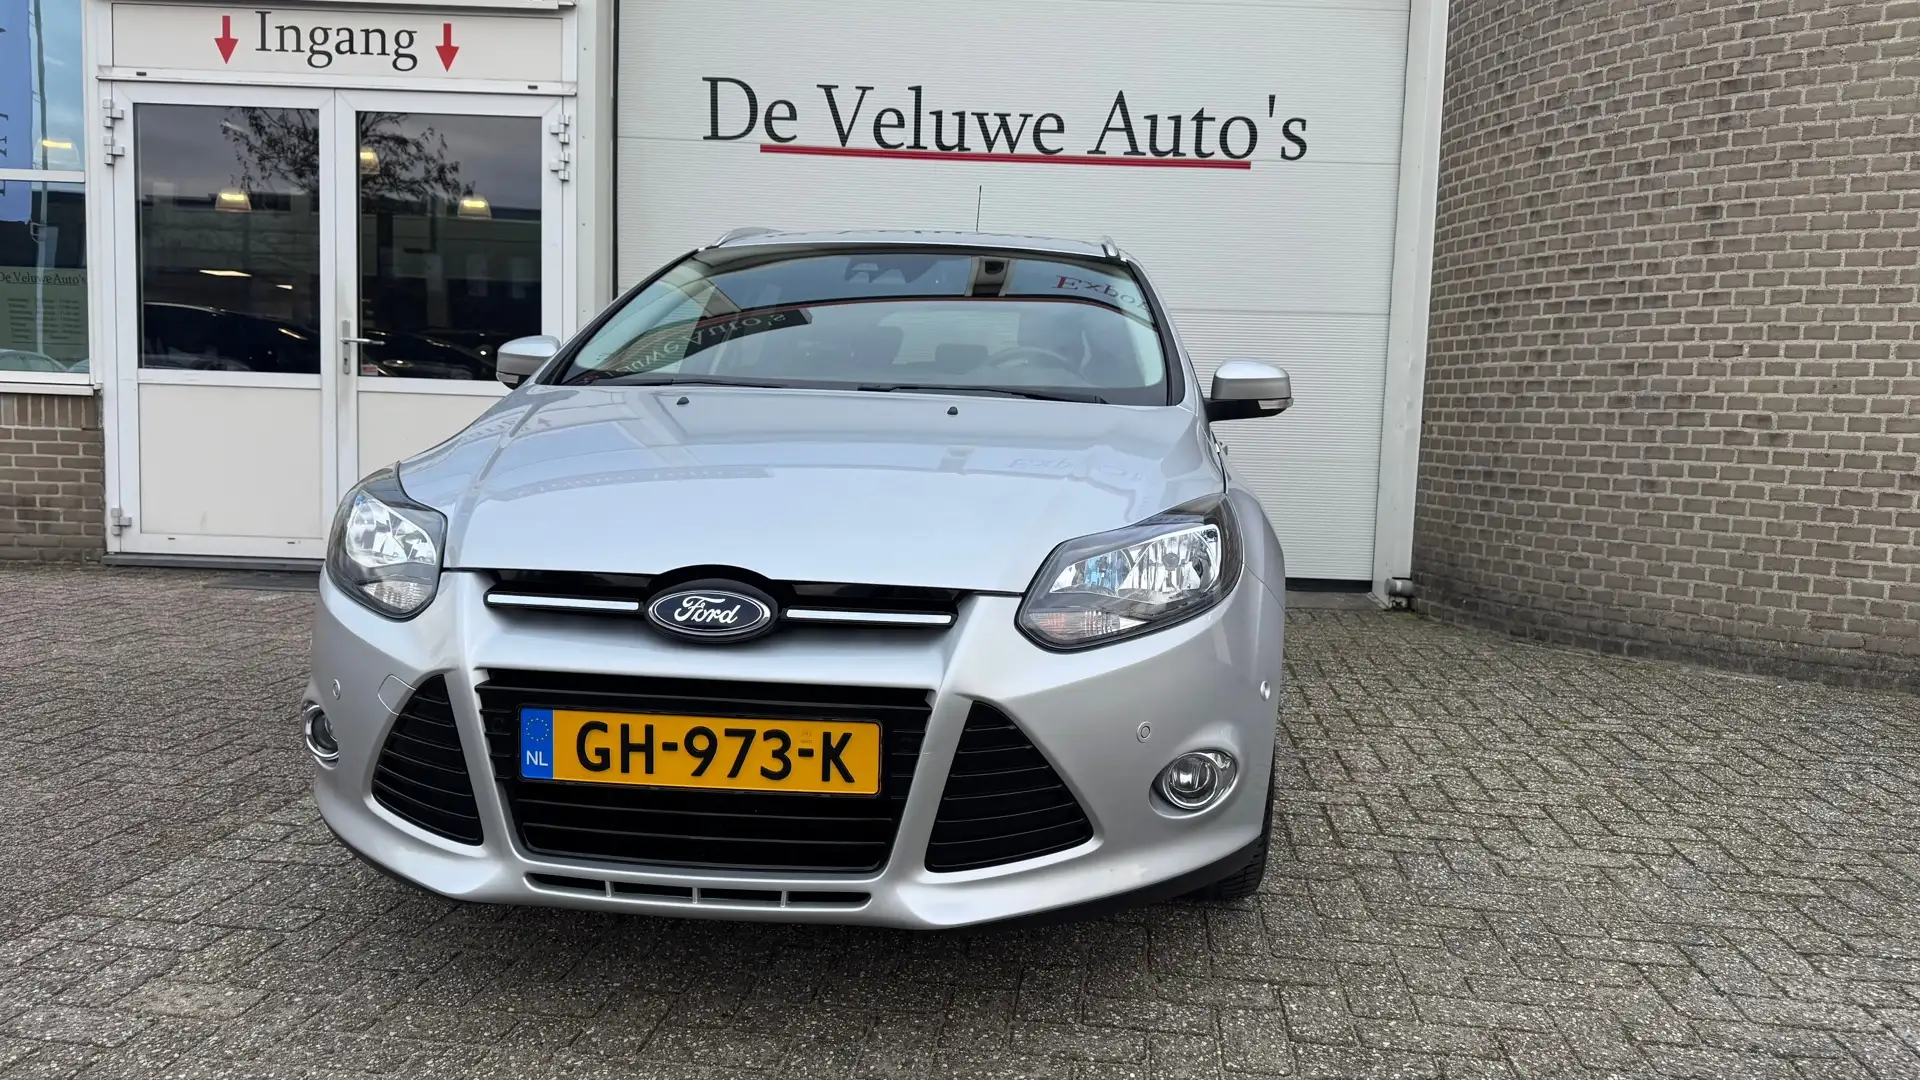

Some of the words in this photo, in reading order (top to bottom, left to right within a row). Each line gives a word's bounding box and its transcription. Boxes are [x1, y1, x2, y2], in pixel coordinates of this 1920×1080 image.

[255, 11, 418, 72] Ingang
[702, 77, 798, 144] De
[817, 84, 1065, 155] Veluwe
[1087, 90, 1308, 162] Auto's
[13, 272, 52, 284] Veluwe
[54, 274, 87, 286] Auto's
[674, 596, 741, 625] Ford
[526, 750, 548, 767] NL
[576, 721, 854, 783] GH-973-K
